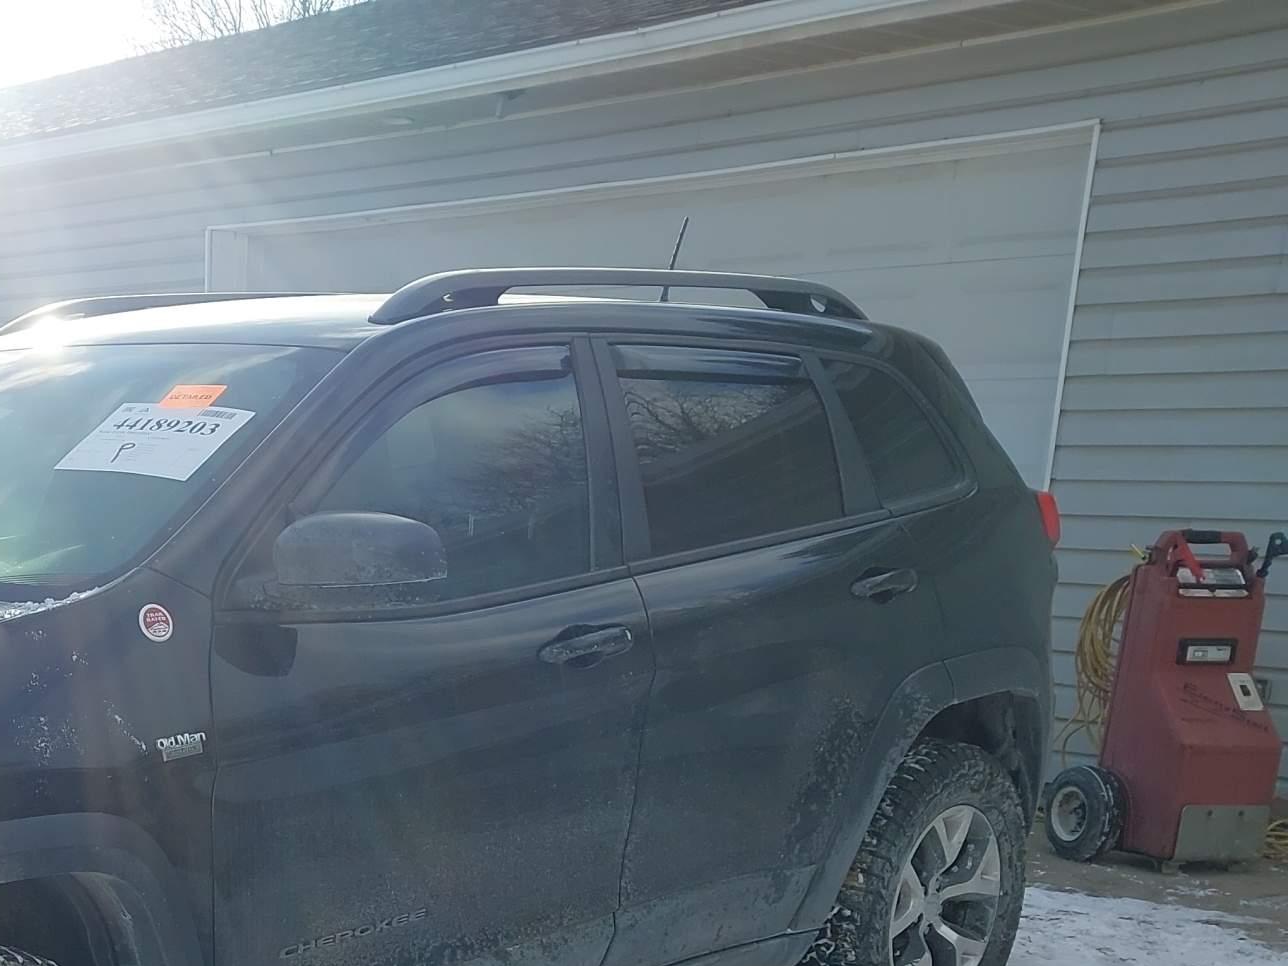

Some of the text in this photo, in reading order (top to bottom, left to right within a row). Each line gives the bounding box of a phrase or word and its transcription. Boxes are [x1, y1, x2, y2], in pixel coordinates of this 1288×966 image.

[113, 417, 221, 436] 44189203
[176, 732, 207, 747] Man
[279, 907, 428, 959] CHEROKEE
